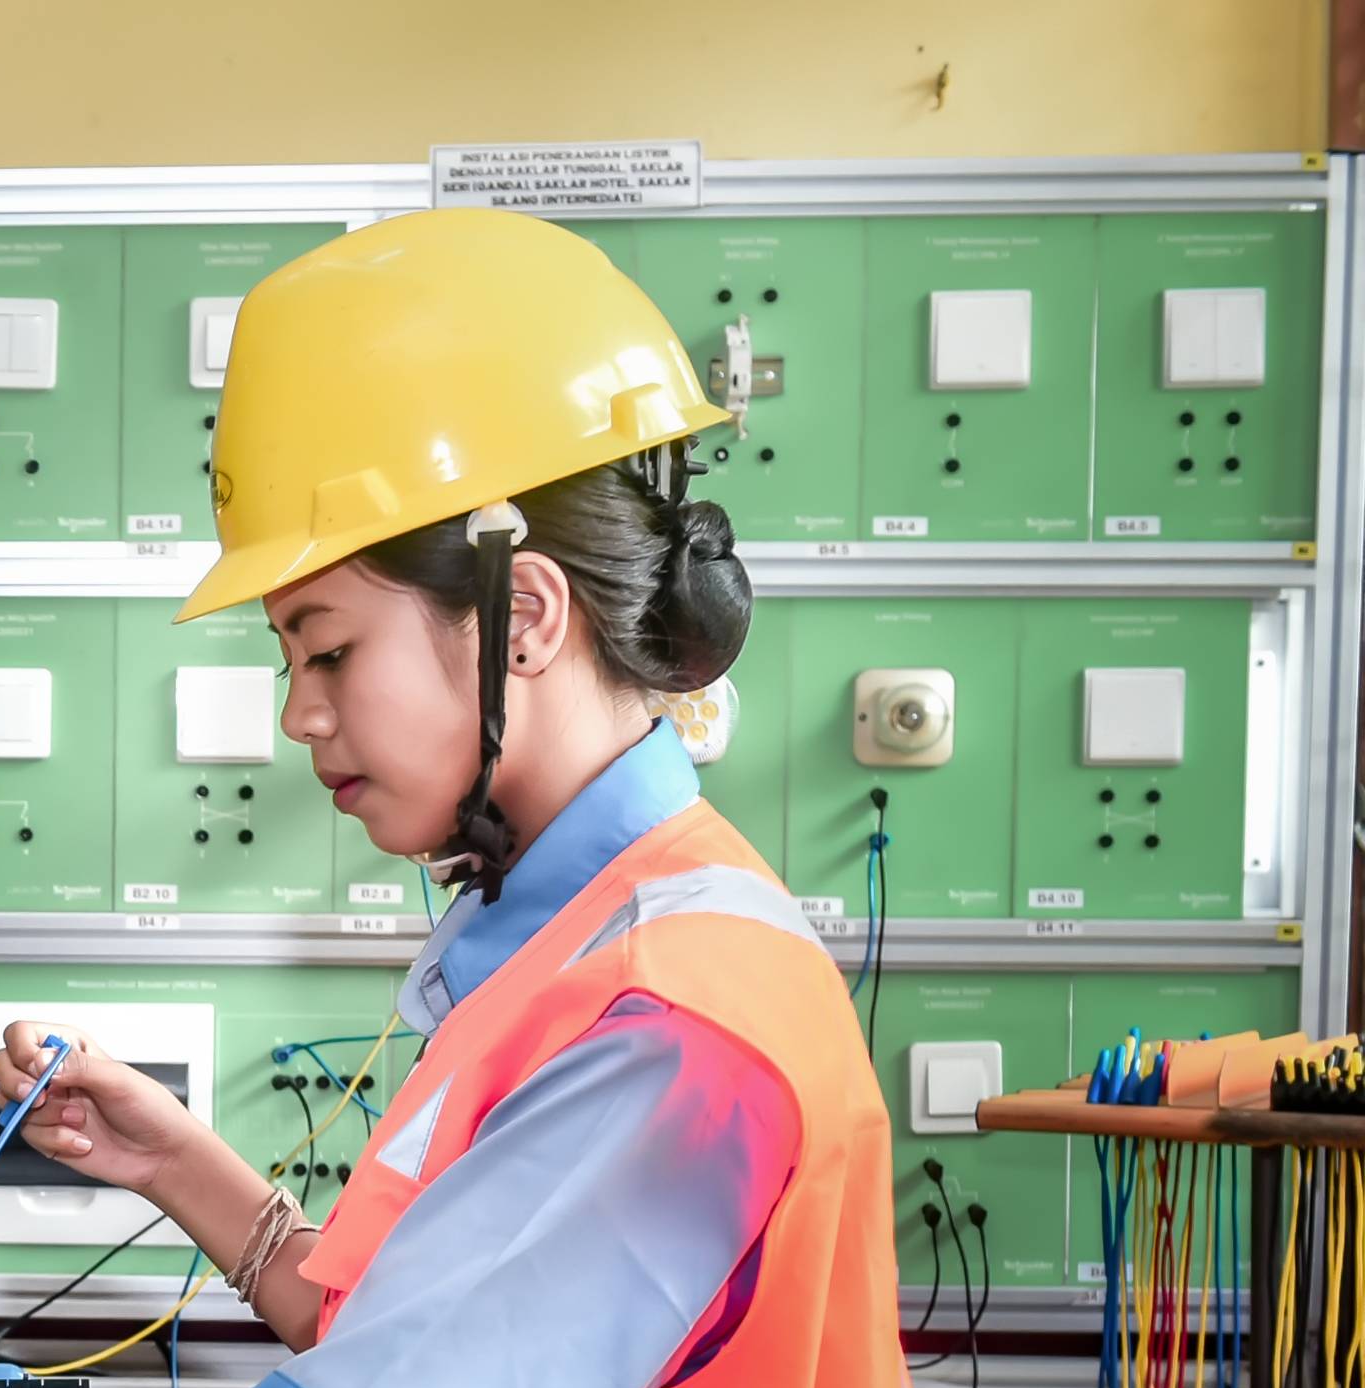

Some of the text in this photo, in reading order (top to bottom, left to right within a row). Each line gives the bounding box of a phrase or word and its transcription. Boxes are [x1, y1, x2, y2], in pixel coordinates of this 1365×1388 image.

[449, 166, 503, 178] DENGAN
[507, 165, 559, 176] SAKLAR
[630, 162, 683, 173] SAKLAR
[535, 178, 587, 190] SAKLAR
[638, 176, 691, 188] SAKLAR
[491, 195, 539, 206] SILANG
